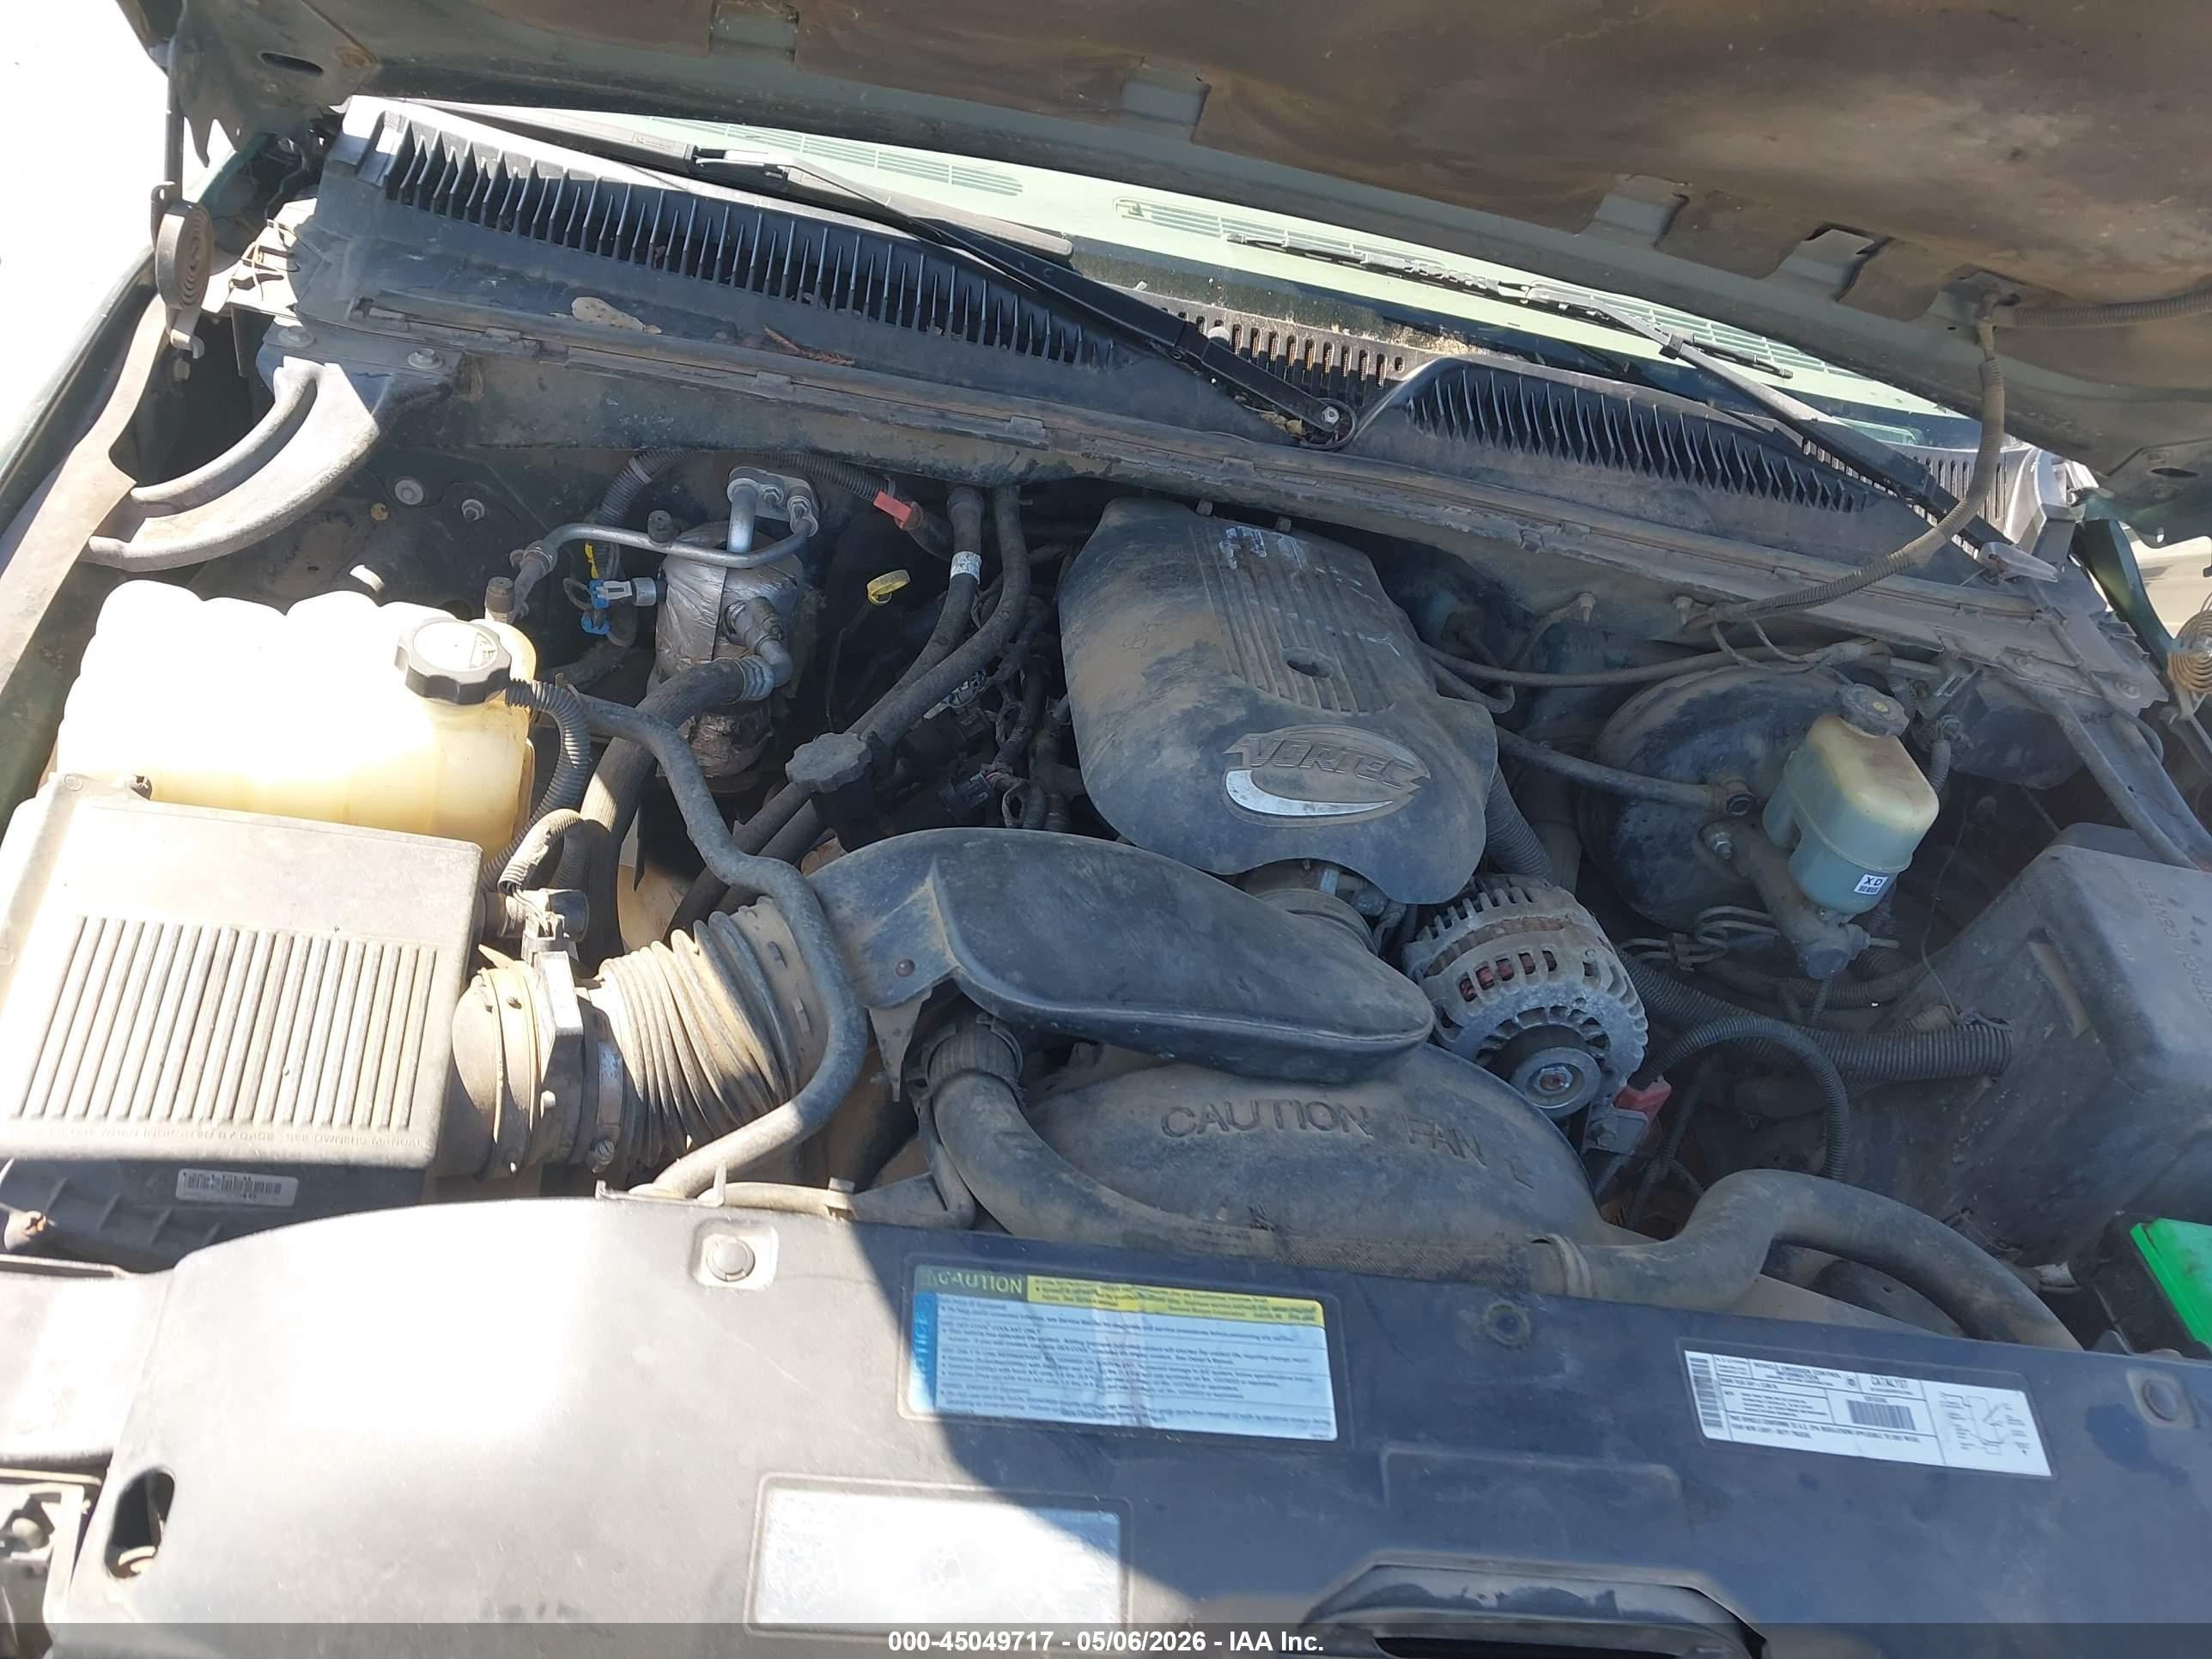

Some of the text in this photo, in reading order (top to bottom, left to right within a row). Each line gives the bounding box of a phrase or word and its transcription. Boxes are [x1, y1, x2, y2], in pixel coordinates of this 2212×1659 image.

[1247, 736, 1416, 790] VORTEC
[1161, 1099, 1375, 1138] CAUTION
[1403, 1113, 1487, 1169] FAN
[937, 1271, 1022, 1295] CAUTION
